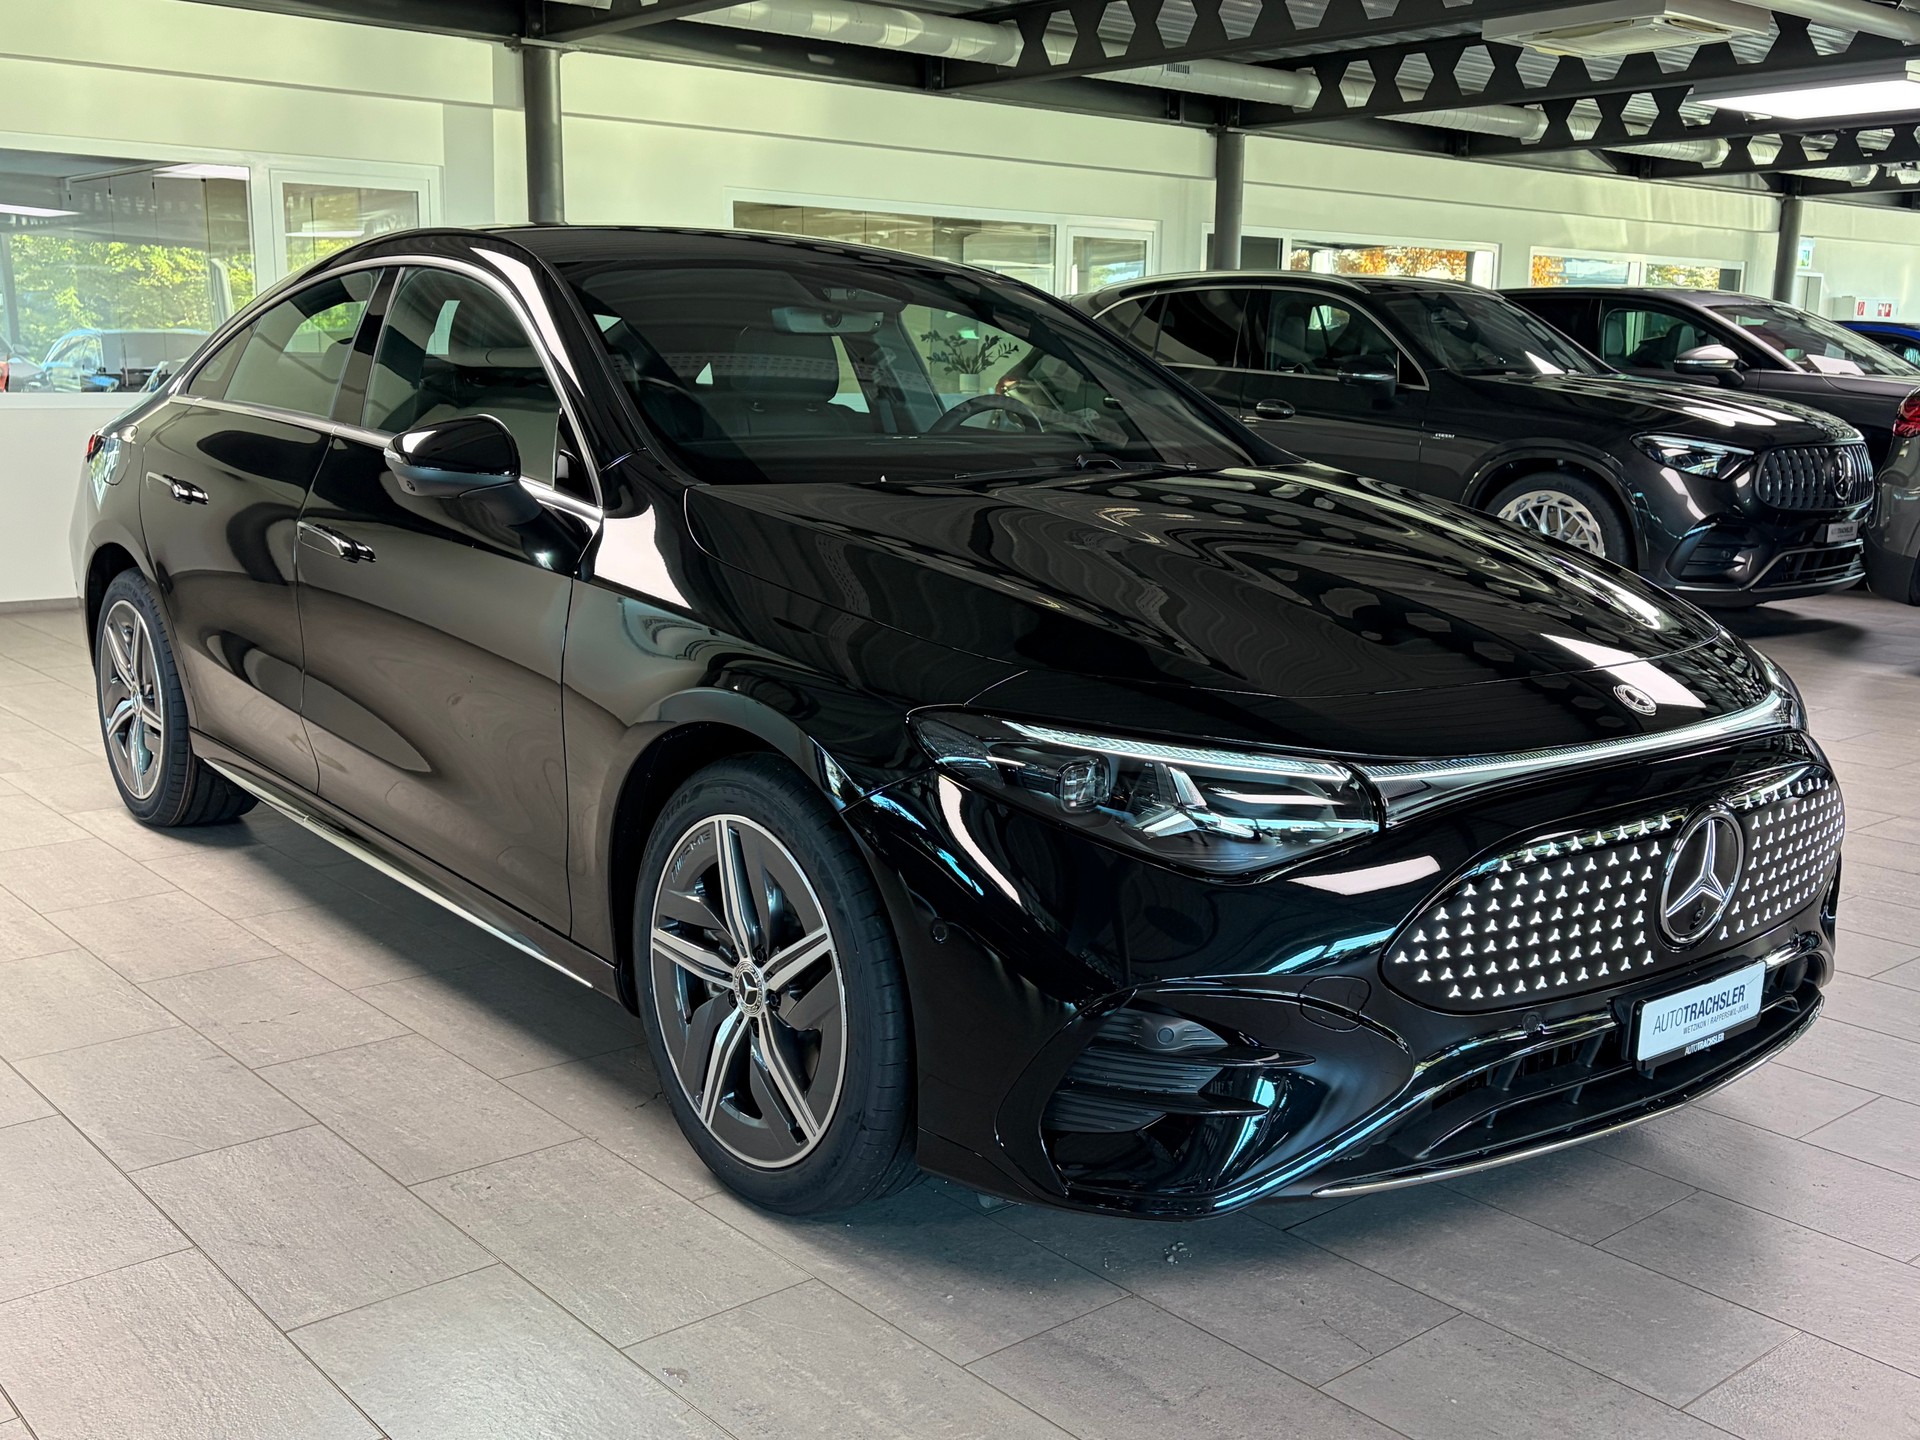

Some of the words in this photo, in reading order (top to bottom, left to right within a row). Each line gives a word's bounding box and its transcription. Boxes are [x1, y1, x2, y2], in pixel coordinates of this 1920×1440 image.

[1652, 984, 1746, 1036] AUTOTRACHSLER
[1683, 1020, 1707, 1035] WETZIKON
[1710, 1003, 1749, 1024] RAPPERSWIL-JONA
[1684, 1032, 1725, 1056] AUTOTRACHSLER
